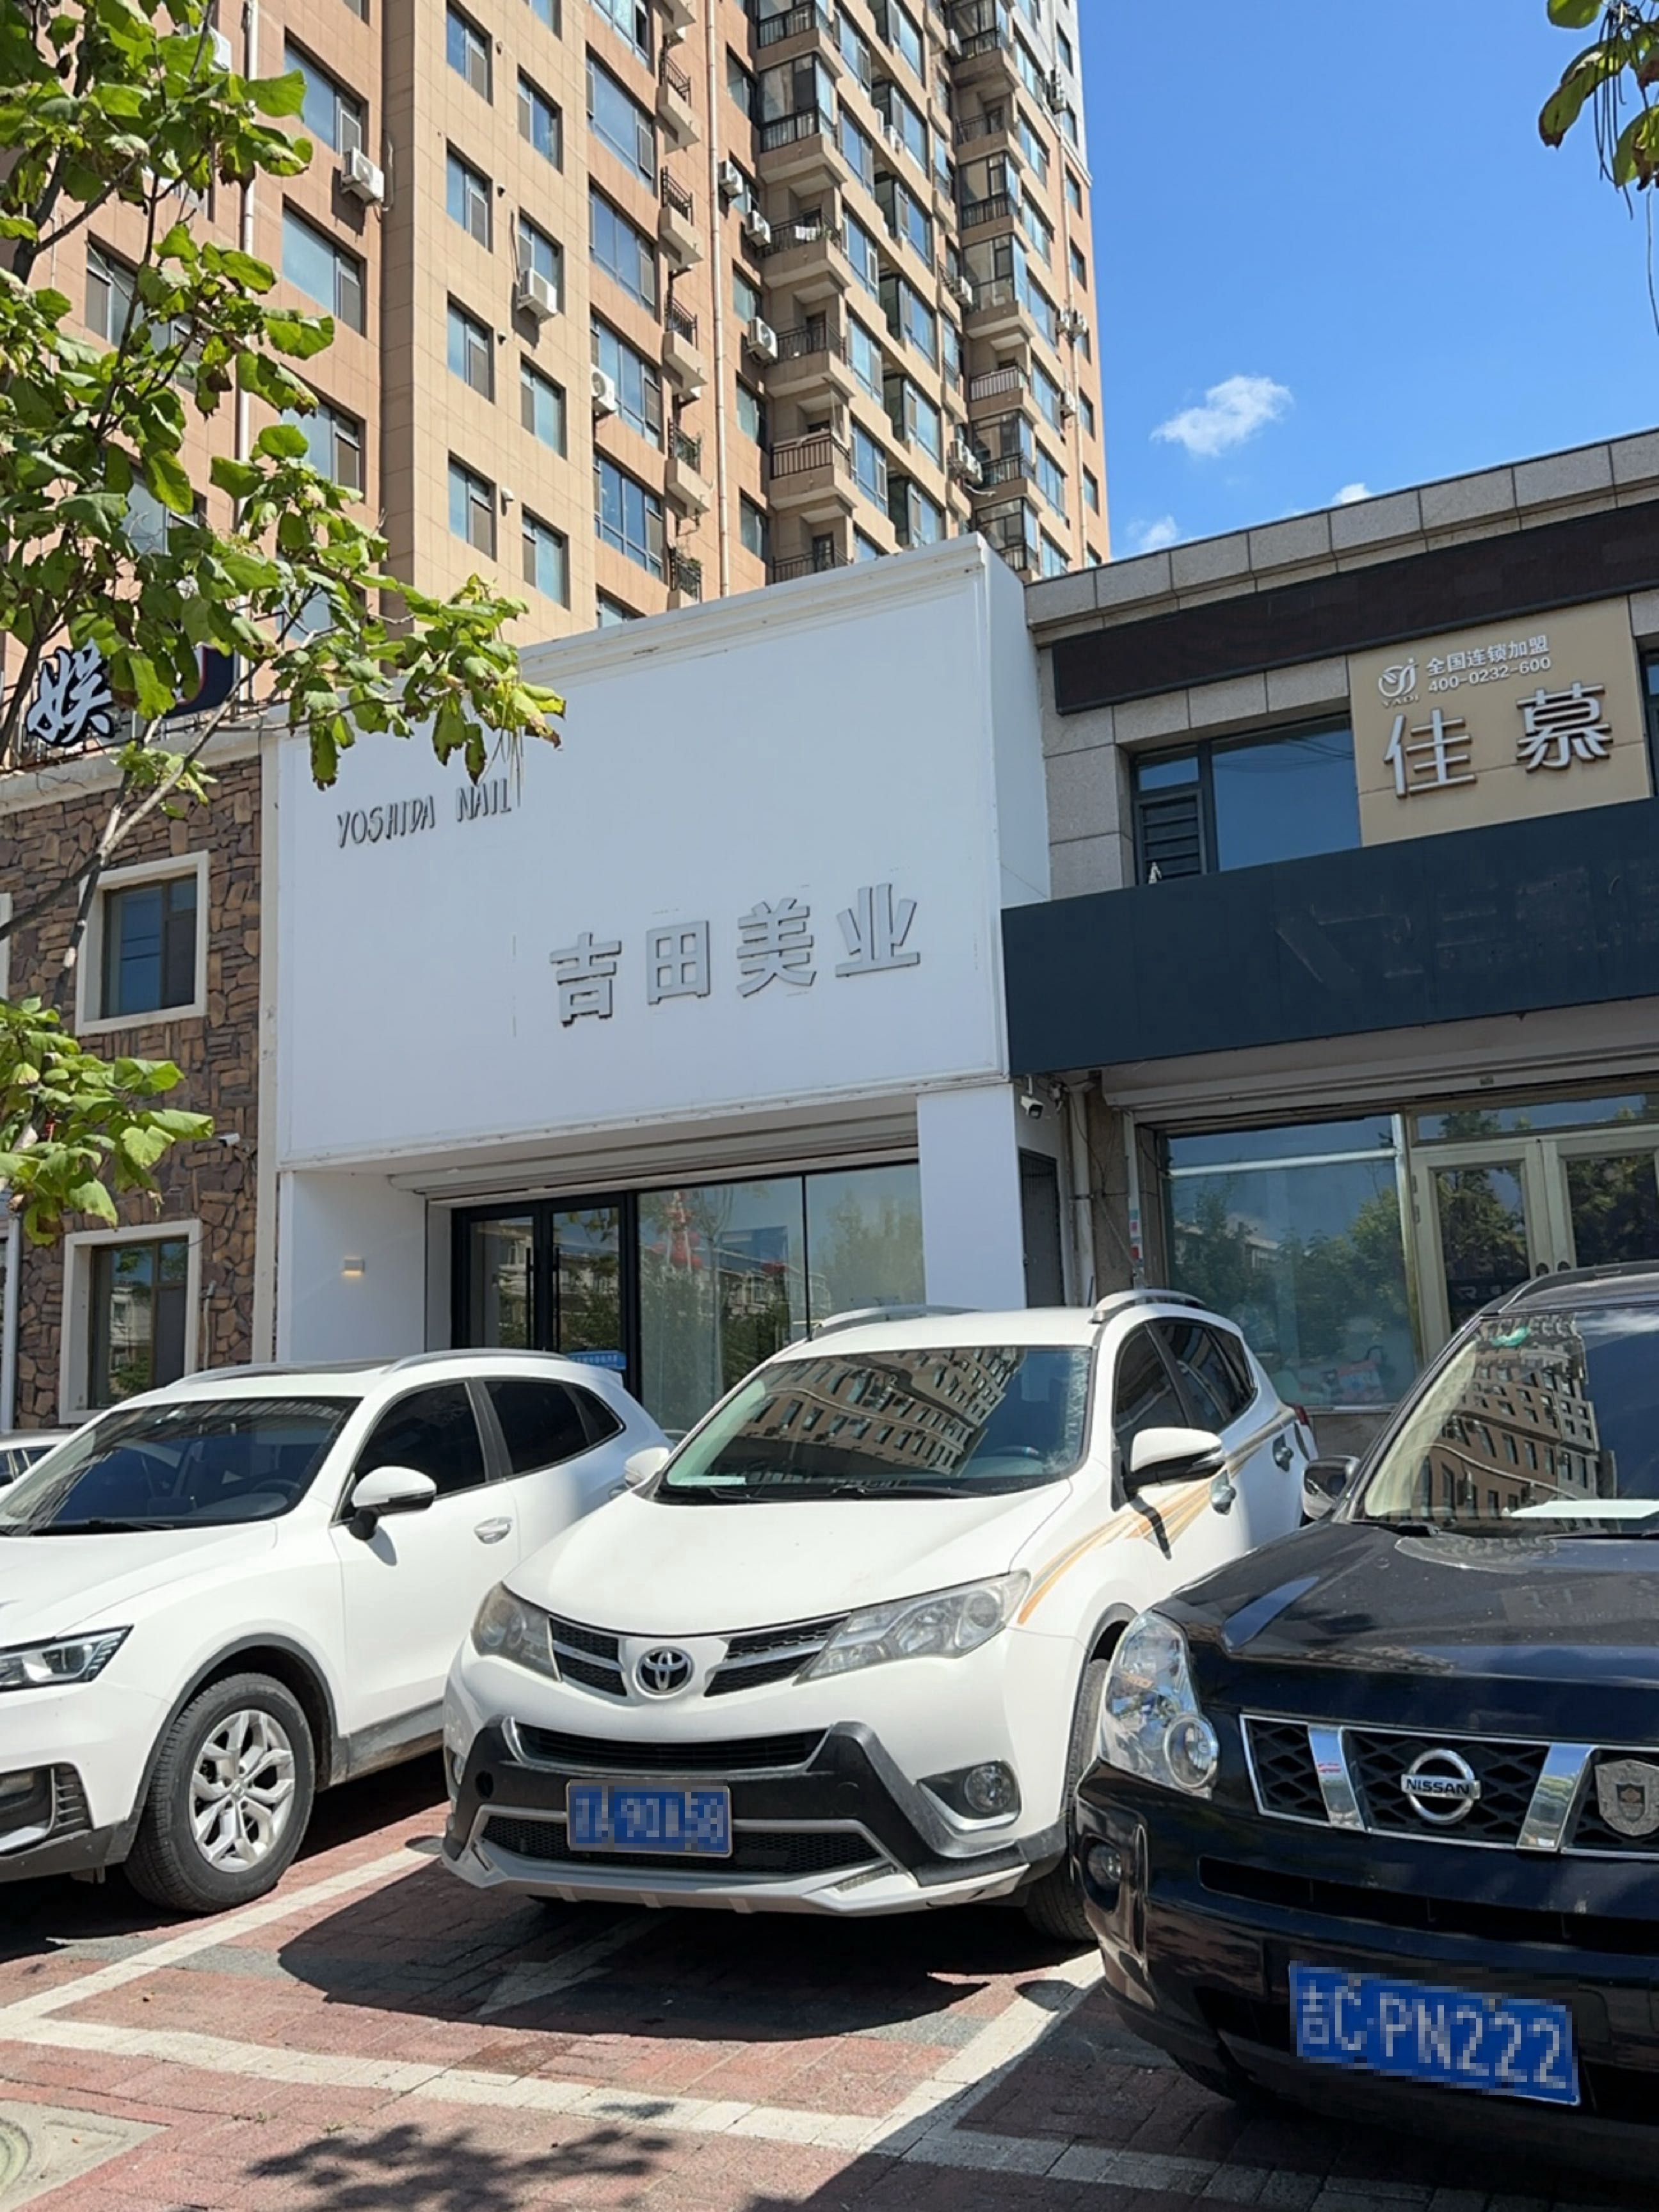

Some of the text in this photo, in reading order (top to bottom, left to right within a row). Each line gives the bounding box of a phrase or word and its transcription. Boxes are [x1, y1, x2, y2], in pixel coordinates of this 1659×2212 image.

[1426, 634, 1550, 677] 全国连锁加盟
[1428, 657, 1551, 693] 400-0232-600
[337, 777, 511, 849] YOSHIDA NAIL
[549, 882, 920, 1027] 吉田美业
[1406, 1777, 1471, 1795] NISSAN
